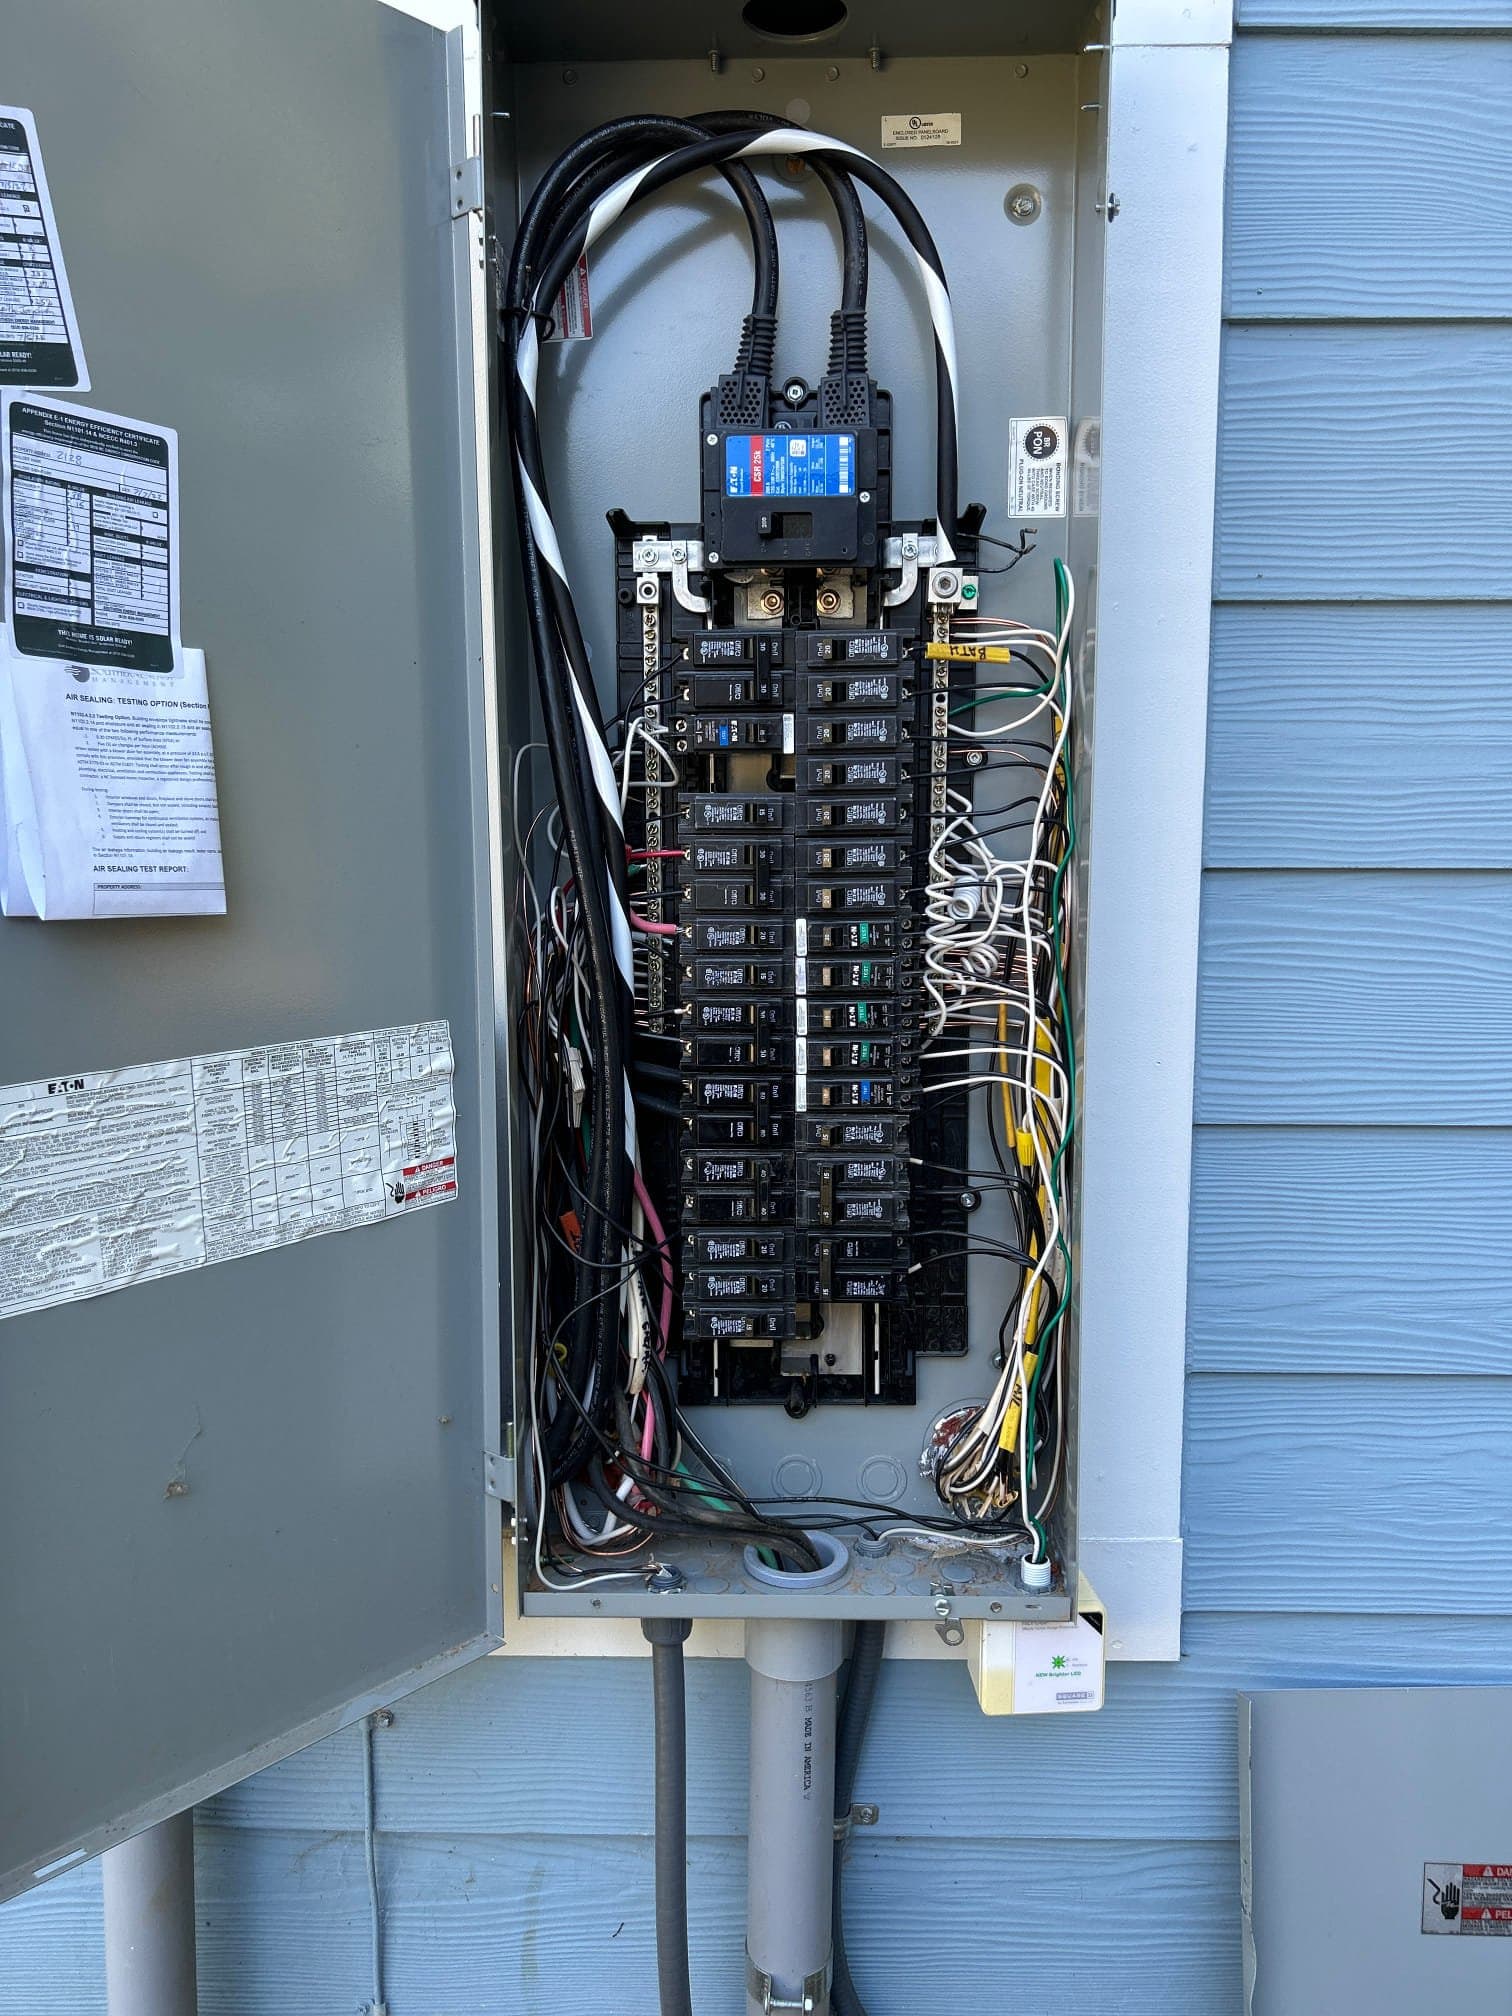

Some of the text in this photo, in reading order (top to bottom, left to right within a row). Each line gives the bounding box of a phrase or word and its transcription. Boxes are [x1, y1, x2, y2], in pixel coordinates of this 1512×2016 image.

[22, 407, 54, 419] APPENDIX
[1033, 431, 1042, 455] PON
[1043, 437, 1051, 447] BR
[753, 450, 761, 482] CSR 25k
[770, 642, 778, 656] On/I
[824, 645, 831, 654] 20
[760, 684, 767, 694] 30
[771, 683, 779, 697] On/I
[825, 687, 831, 696] 20
[65, 693, 207, 710] AIR SEALING: TESTING OPTION (Section
[823, 729, 830, 738] 20
[824, 770, 830, 778] 20
[759, 808, 765, 816] 15
[823, 811, 830, 820] 20
[823, 853, 830, 862] 20
[107, 865, 139, 873] SEALING
[823, 895, 830, 904] 20
[760, 931, 766, 940] 20
[822, 1133, 829, 1141] 15
[421, 1160, 444, 1171] DANGER
[422, 1184, 447, 1195] PELIGRO
[761, 1245, 767, 1253] 20
[823, 1248, 829, 1256] 15
[761, 1284, 767, 1292] 20
[823, 1288, 829, 1296] 15
[804, 1717, 812, 1737] MADE
[803, 1756, 812, 1791] AMERICA
